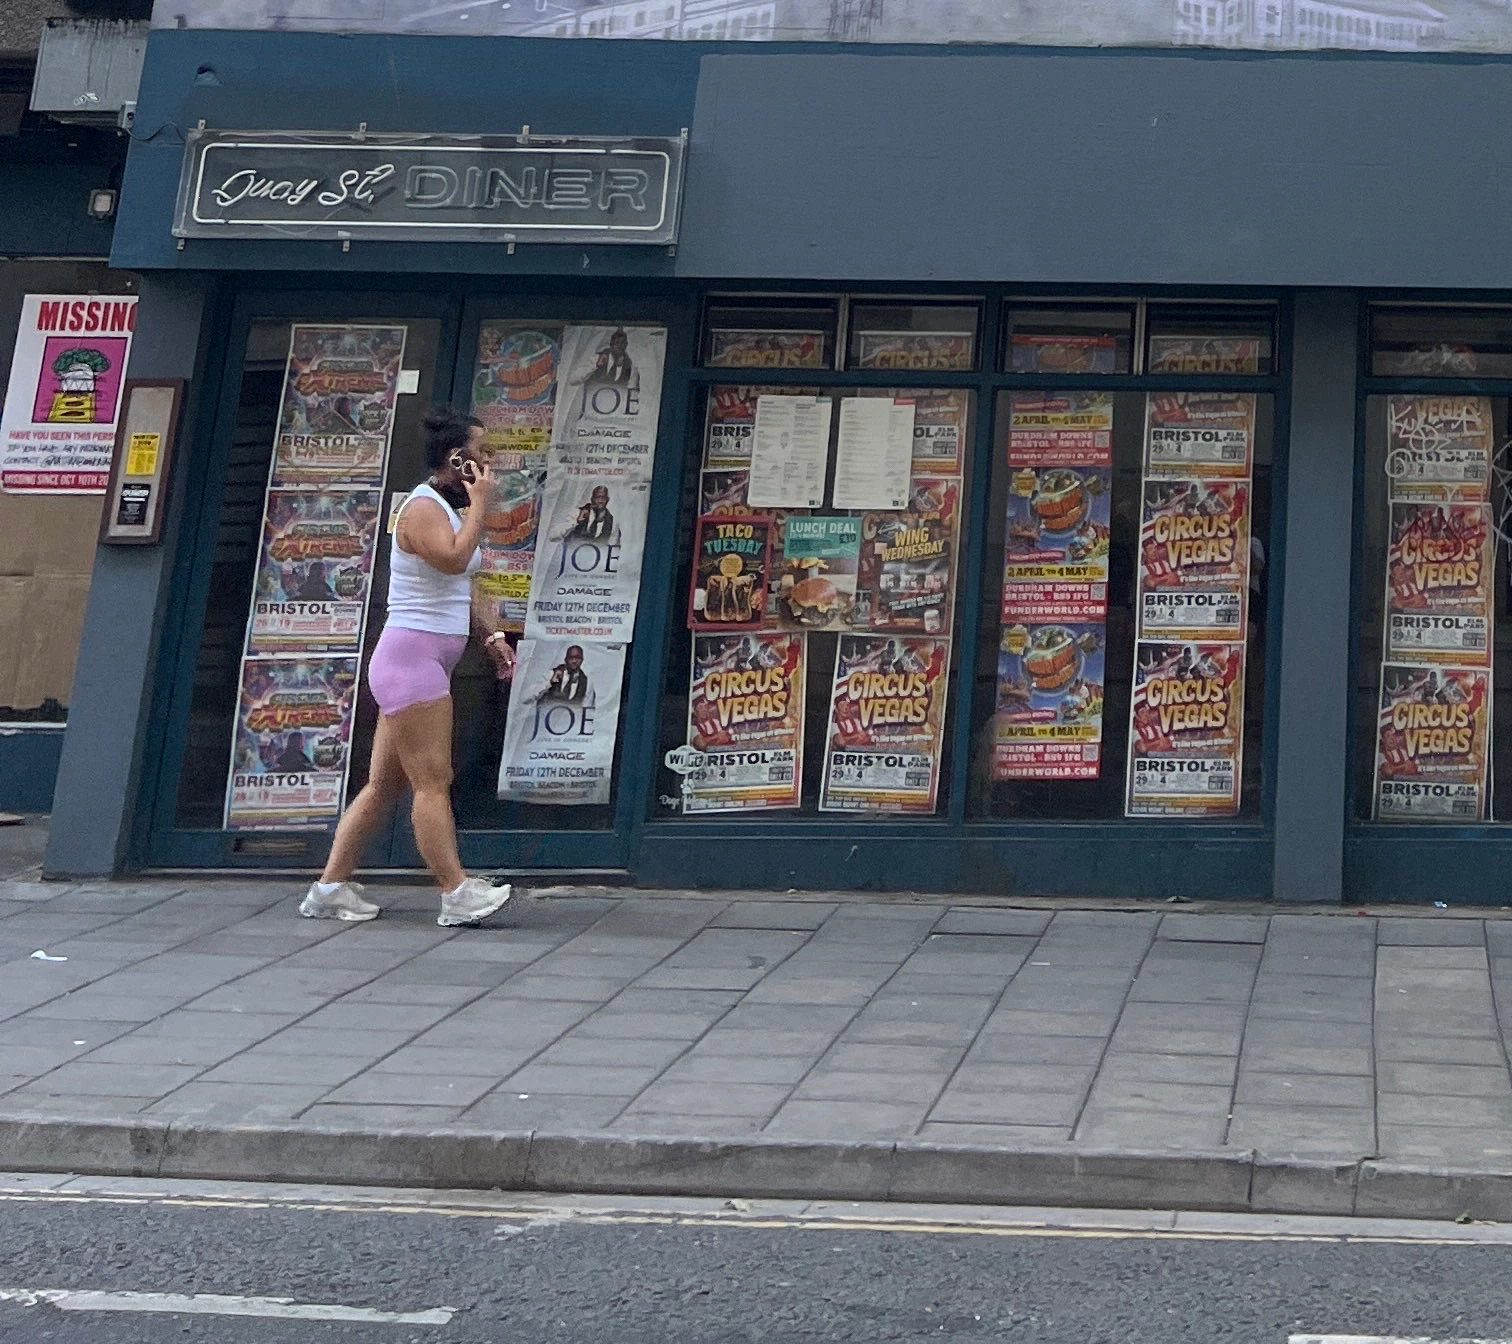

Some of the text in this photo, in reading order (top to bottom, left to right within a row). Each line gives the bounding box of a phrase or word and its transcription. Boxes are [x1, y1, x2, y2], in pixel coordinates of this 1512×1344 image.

[212, 170, 319, 207] Quay
[404, 165, 649, 213] DINER
[577, 387, 640, 421] JOE
[1021, 415, 1093, 425] APRIL MAY
[281, 436, 357, 447] BRISTOL
[1152, 430, 1222, 442] BRISTOL
[607, 444, 649, 454] DECEMBER
[716, 524, 754, 538] TACO
[790, 523, 857, 534] LUNCH DEAL
[1154, 514, 1231, 542] CIRCUS
[894, 528, 929, 547] WING
[704, 540, 764, 554] TUESDAY
[880, 540, 945, 562] WEDNESDAY
[1167, 538, 1234, 569] VEGAS
[556, 543, 621, 579] JOE
[1016, 567, 1045, 577] APRIL
[1065, 566, 1088, 576] MAY
[1415, 561, 1479, 590] VEGAS
[557, 587, 613, 596] DAMAGE
[535, 601, 630, 613] FRIDAY 12TH DECEMBER
[1145, 595, 1216, 606] BRISTOL
[257, 603, 331, 615] BRISTOL
[1392, 615, 1465, 630] BRISTOL
[703, 667, 787, 702] CIRCUS
[848, 671, 929, 700] CIRCUS
[1147, 679, 1225, 706] CIRCUS
[717, 692, 787, 729] VEGAS
[857, 696, 929, 728] VEGAS
[1393, 702, 1470, 731] CIRCUS
[529, 706, 595, 742] JOE
[1159, 702, 1228, 734] VEGAS
[1007, 727, 1036, 737] APRIL
[1057, 726, 1080, 737] MAY
[1404, 728, 1474, 757] VEGAS
[529, 752, 585, 760] DAMAGE
[832, 753, 907, 768] BRISTOL
[505, 767, 604, 778] FRIDAY 12TH DECEMBER
[999, 767, 1097, 777] UNDERWORLD.COM
[1136, 761, 1209, 772] BRISTOL
[234, 775, 310, 787] BRISTOL
[1382, 783, 1454, 797] BRISTOL
